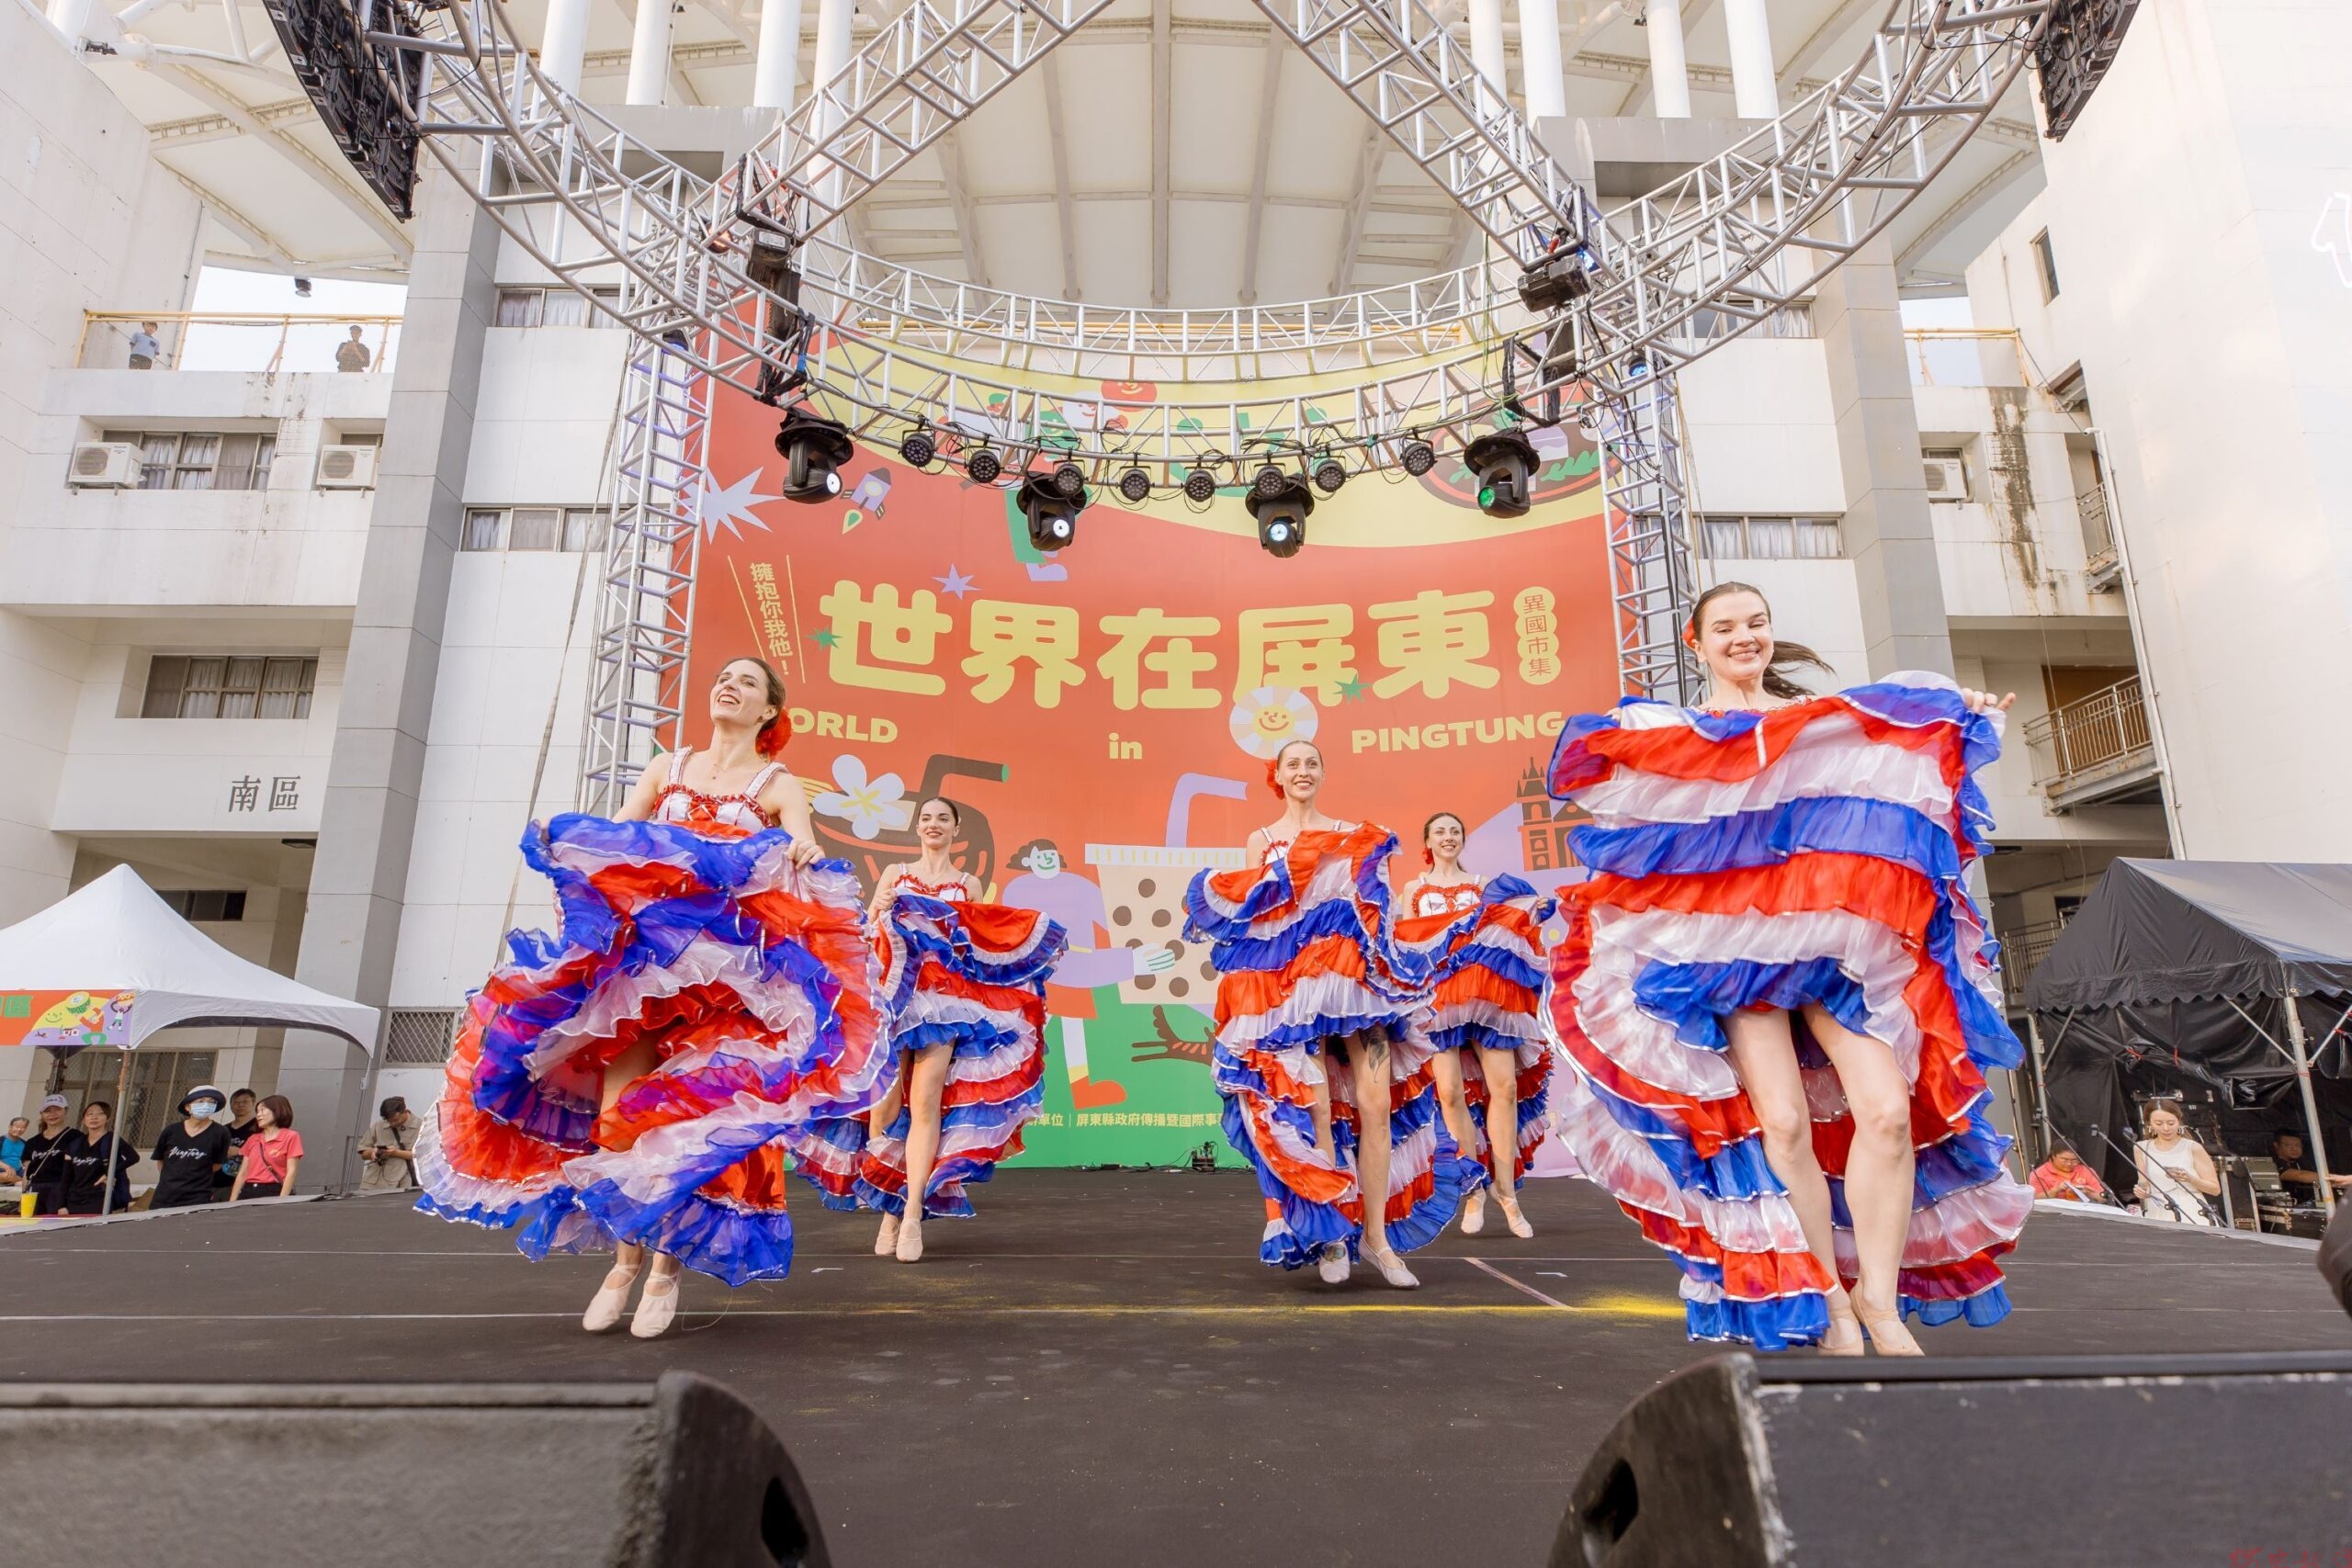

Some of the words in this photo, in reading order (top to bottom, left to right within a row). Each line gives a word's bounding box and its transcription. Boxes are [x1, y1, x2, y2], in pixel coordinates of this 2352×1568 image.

[820, 580, 1500, 711] 世界在屏東
[1523, 594, 1552, 677] 異國市集
[788, 707, 899, 743] ORLD
[1109, 733, 1143, 761] in
[1352, 711, 1566, 754] PINGTUNG
[229, 775, 300, 812] 南區
